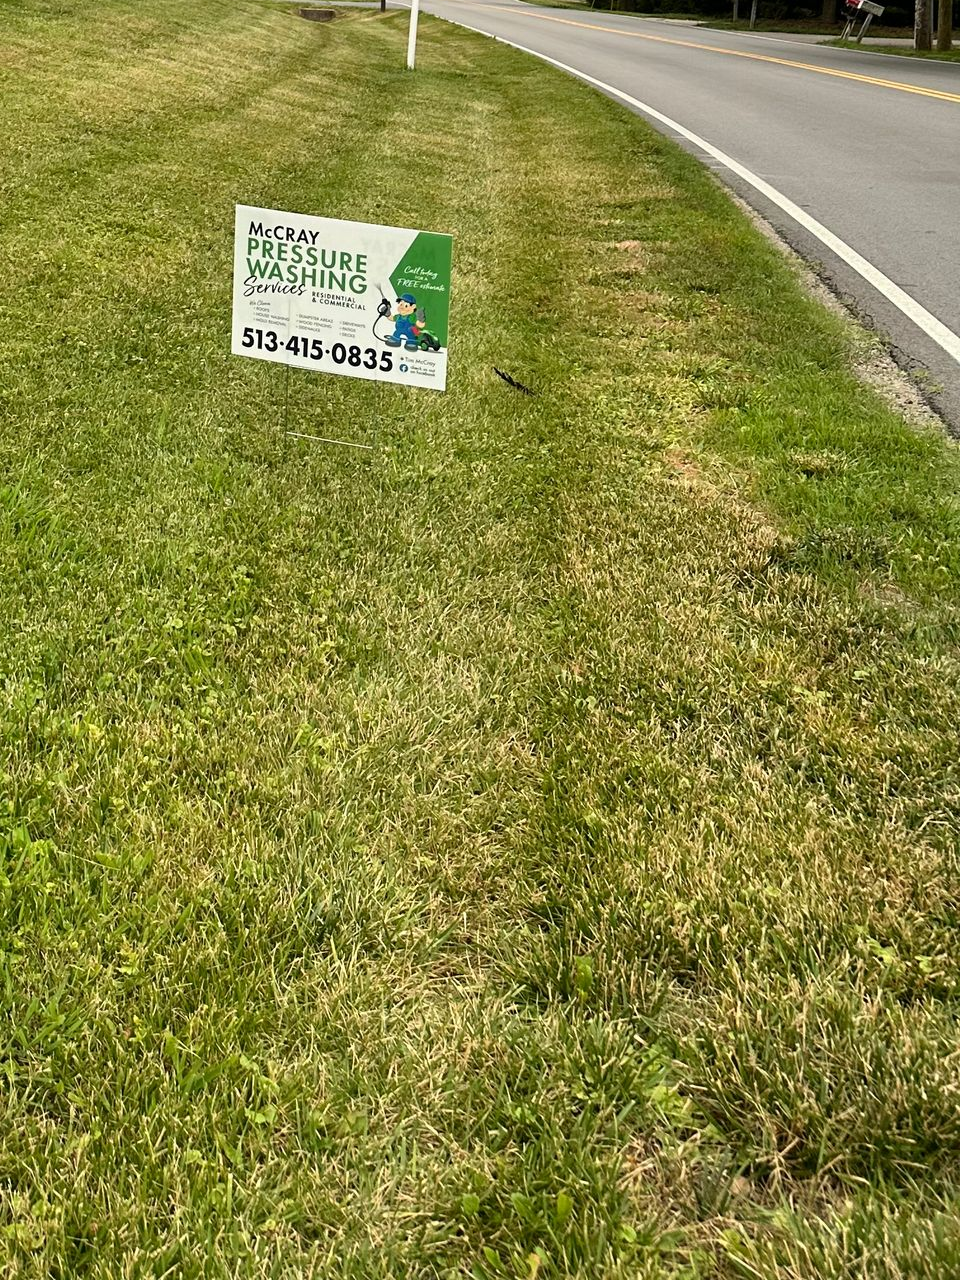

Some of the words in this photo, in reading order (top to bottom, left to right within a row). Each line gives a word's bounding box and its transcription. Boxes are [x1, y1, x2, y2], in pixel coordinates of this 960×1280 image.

[249, 221, 320, 245] McCRAY
[248, 237, 368, 274] PRESSURE
[246, 257, 368, 294] WASHING
[404, 265, 421, 274] Call
[420, 268, 438, 280] today
[243, 275, 307, 297] Services
[397, 278, 421, 288] FREE
[311, 291, 356, 303] RESIDENTIAL
[319, 298, 366, 311] COMMERCIAL
